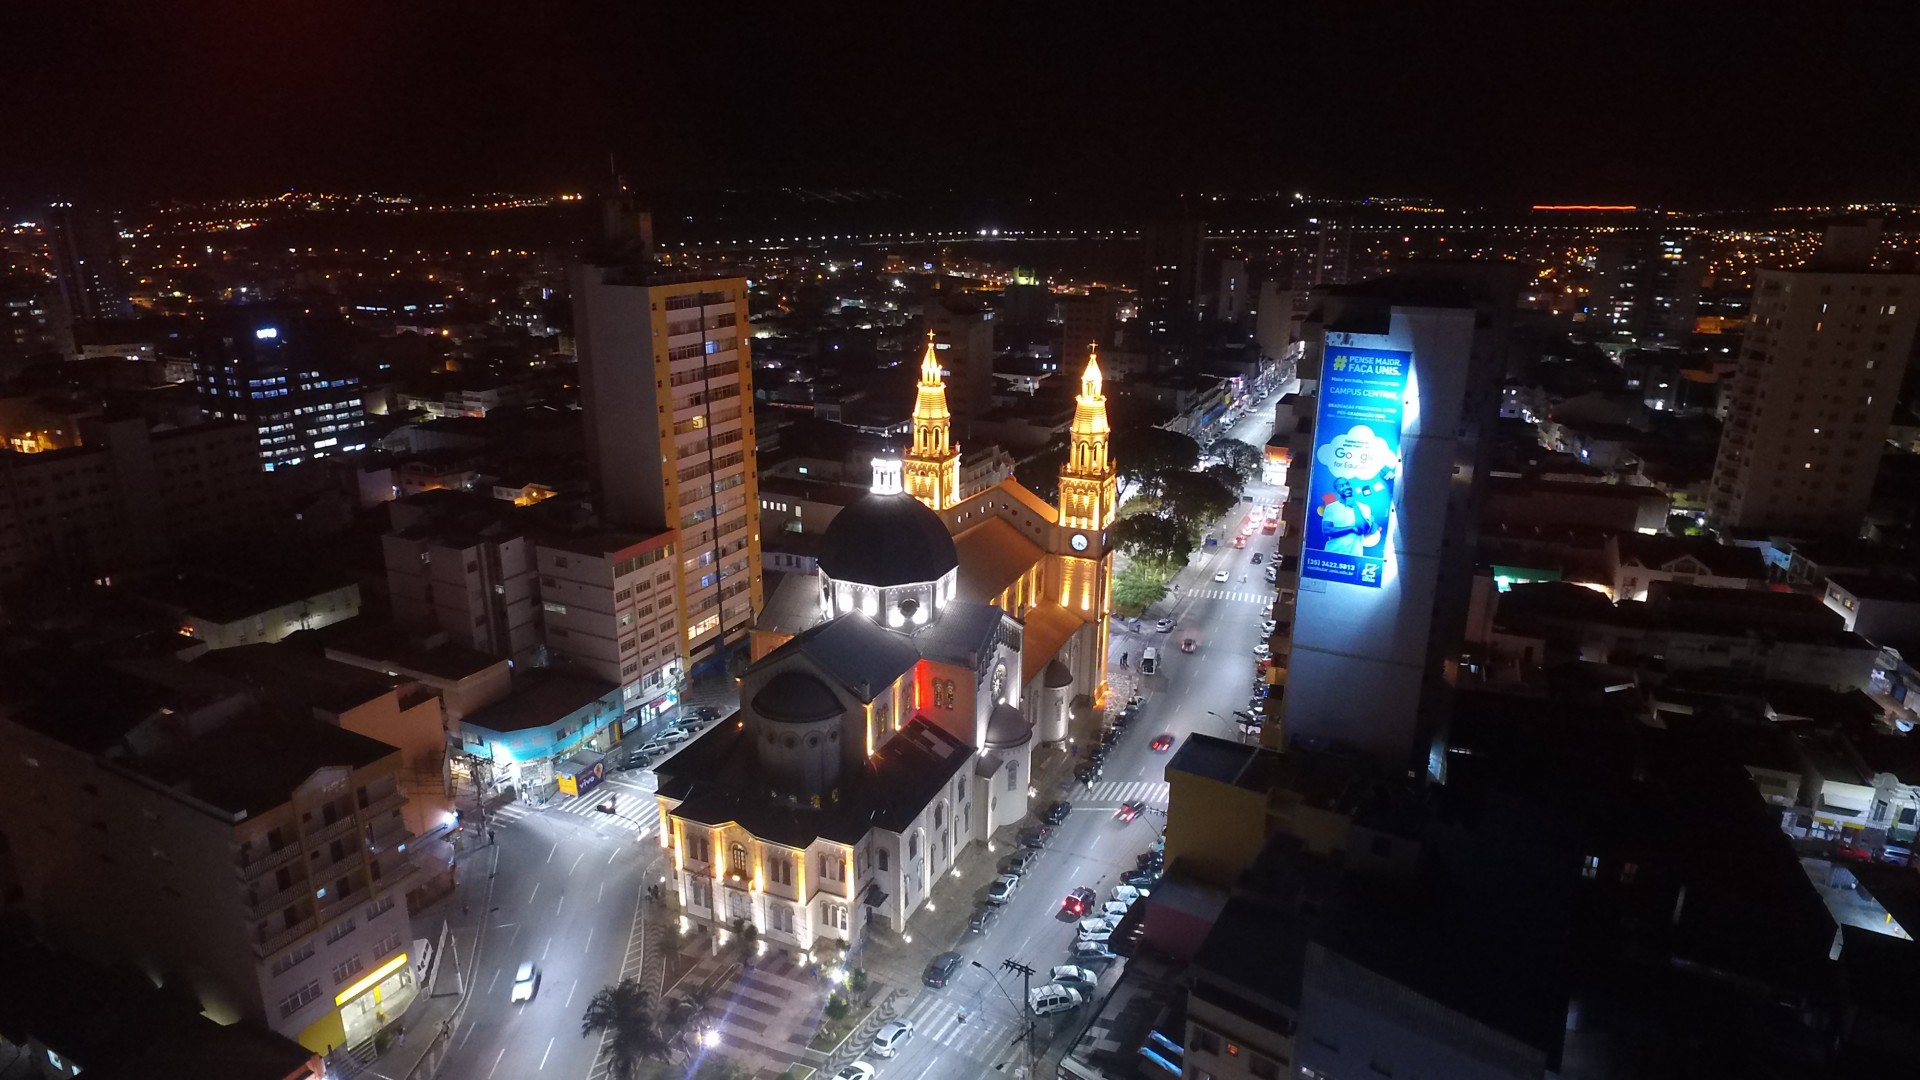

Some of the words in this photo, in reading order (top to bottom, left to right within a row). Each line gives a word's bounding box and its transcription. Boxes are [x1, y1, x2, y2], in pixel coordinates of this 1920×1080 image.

[1349, 356, 1374, 364] PENSE
[1375, 358, 1402, 366] MAIOR.
[1348, 364, 1373, 375] FAÇA
[1375, 366, 1401, 376] UNIS.
[1330, 387, 1362, 396] CAMPUS
[1307, 558, 1320, 567] (35)
[579, 776, 595, 789] vivo
